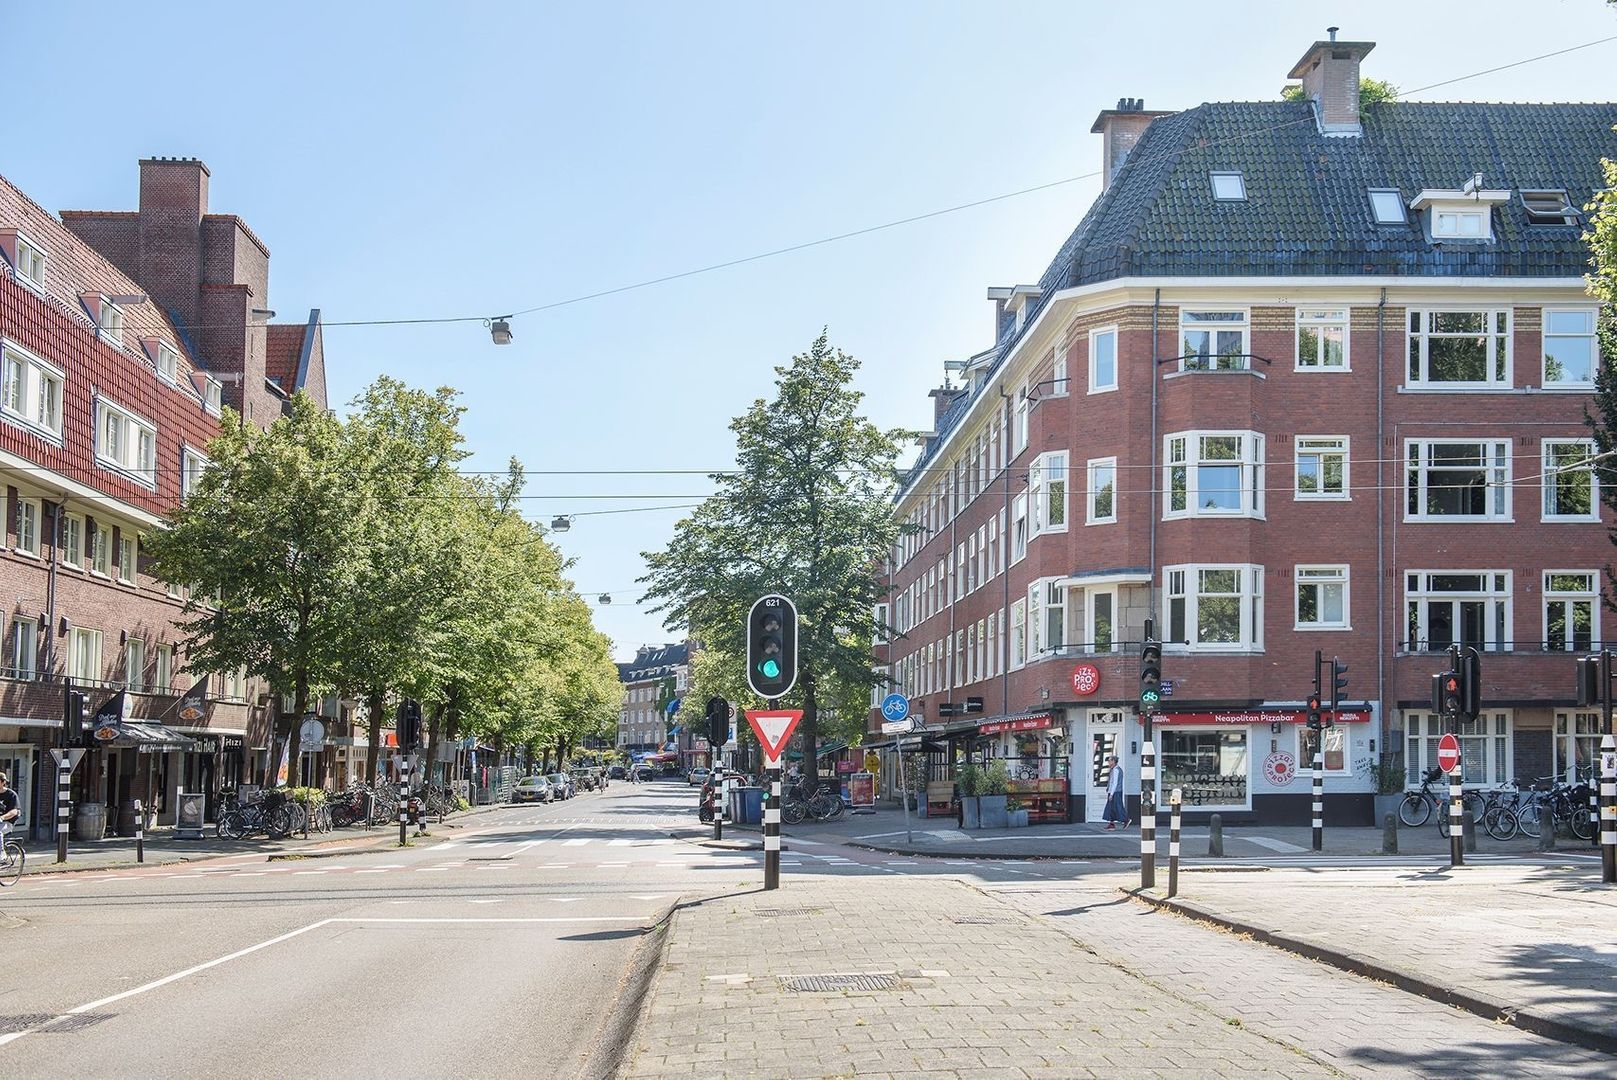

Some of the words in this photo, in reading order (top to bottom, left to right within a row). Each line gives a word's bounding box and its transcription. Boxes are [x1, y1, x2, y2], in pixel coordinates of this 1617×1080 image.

[765, 598, 780, 607] 621
[1214, 714, 1260, 723] Neapolitan
[1260, 713, 1295, 722] Pizzabar
